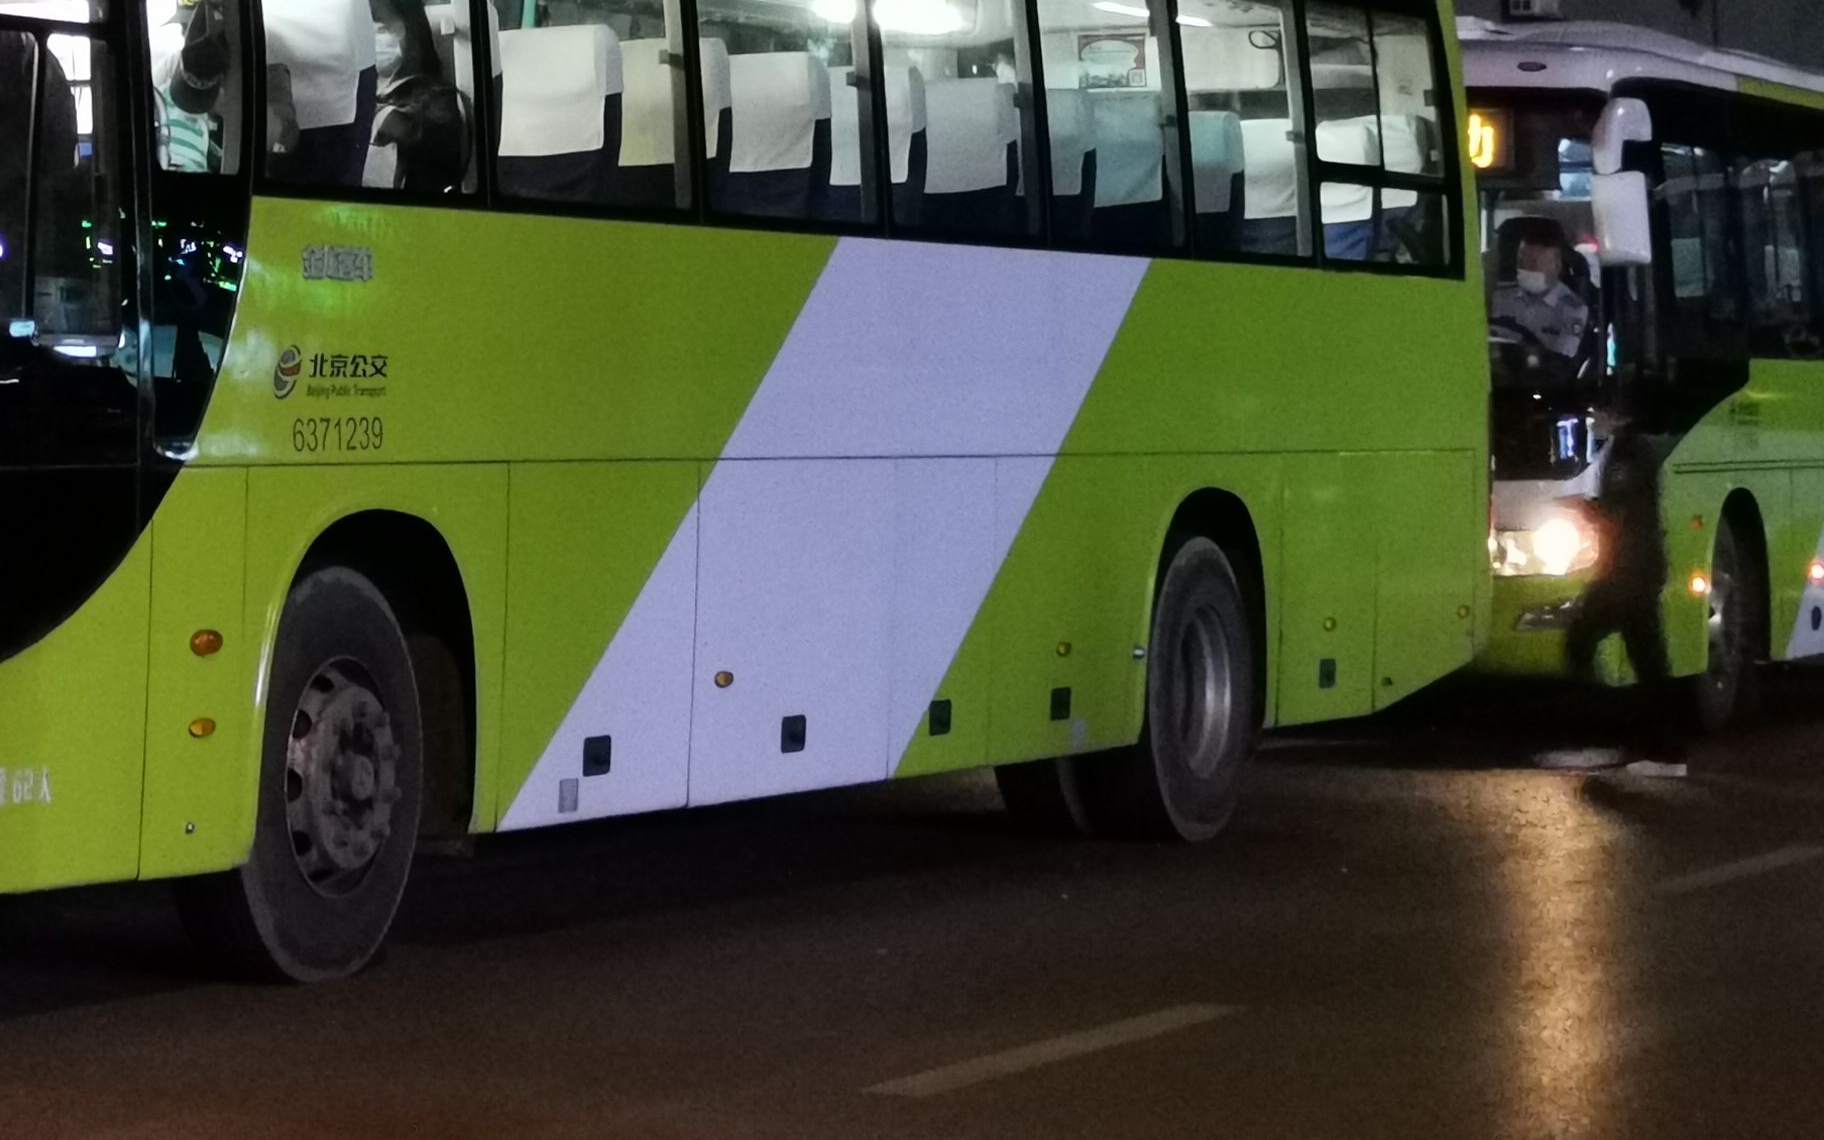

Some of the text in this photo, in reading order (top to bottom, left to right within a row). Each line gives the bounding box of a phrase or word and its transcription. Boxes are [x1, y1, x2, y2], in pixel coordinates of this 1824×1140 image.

[308, 352, 389, 378] 北京公交
[292, 416, 384, 452] 6371239
